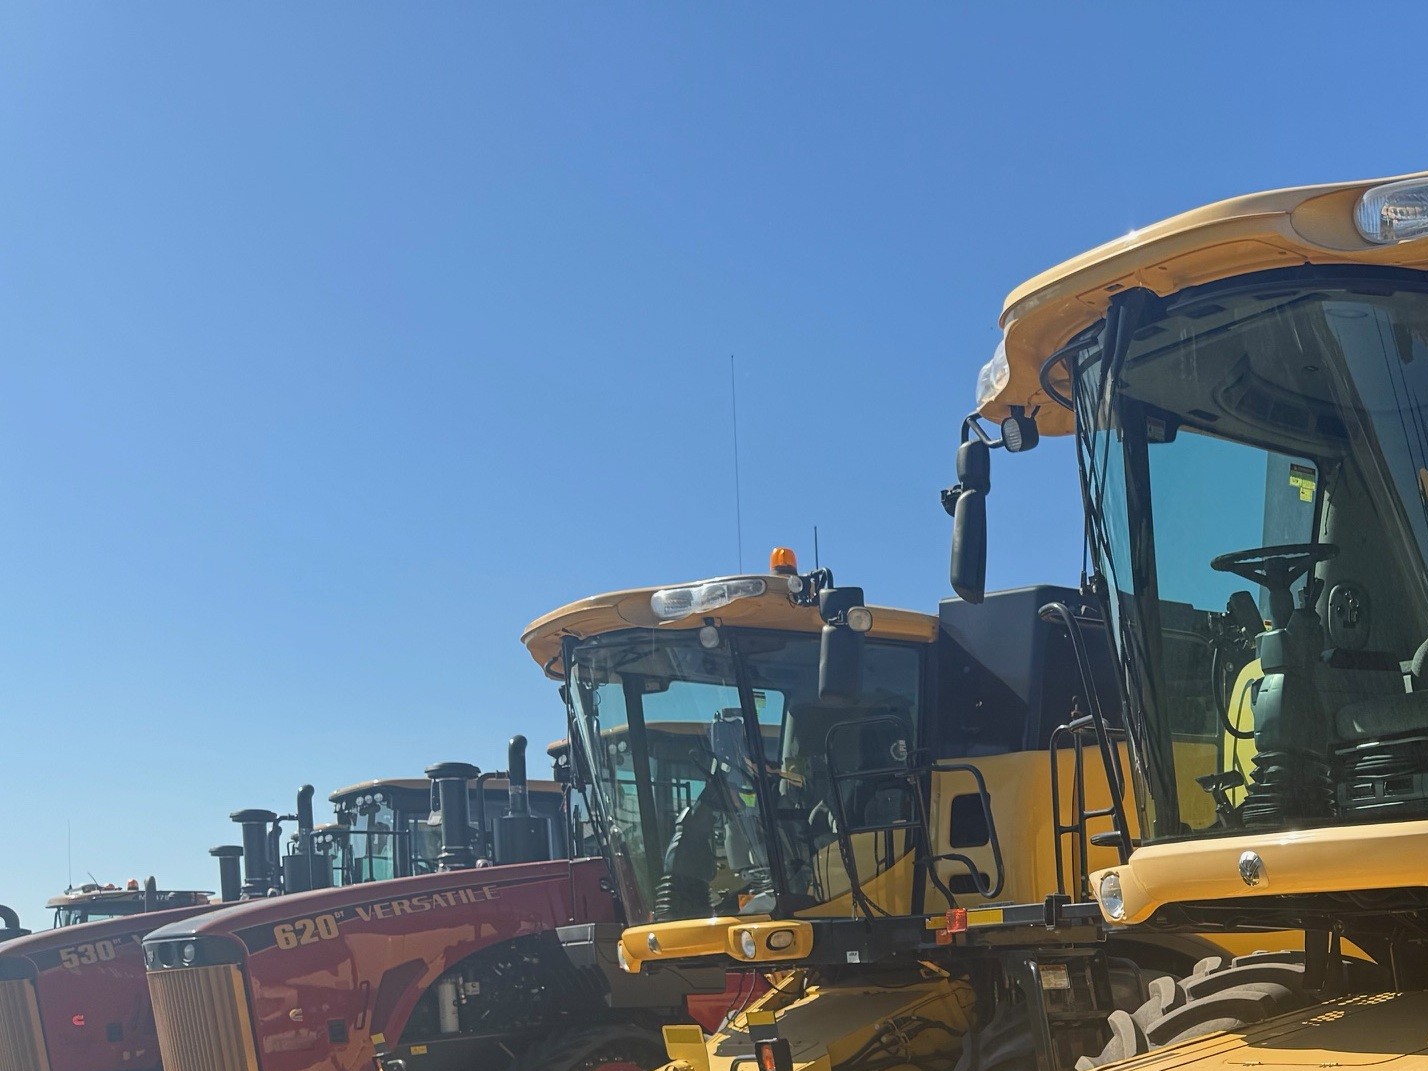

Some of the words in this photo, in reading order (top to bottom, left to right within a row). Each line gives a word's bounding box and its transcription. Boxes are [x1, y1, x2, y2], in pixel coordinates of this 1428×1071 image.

[273, 913, 340, 951] 620
[355, 884, 501, 922] VERSATILE
[59, 940, 115, 969] 530
